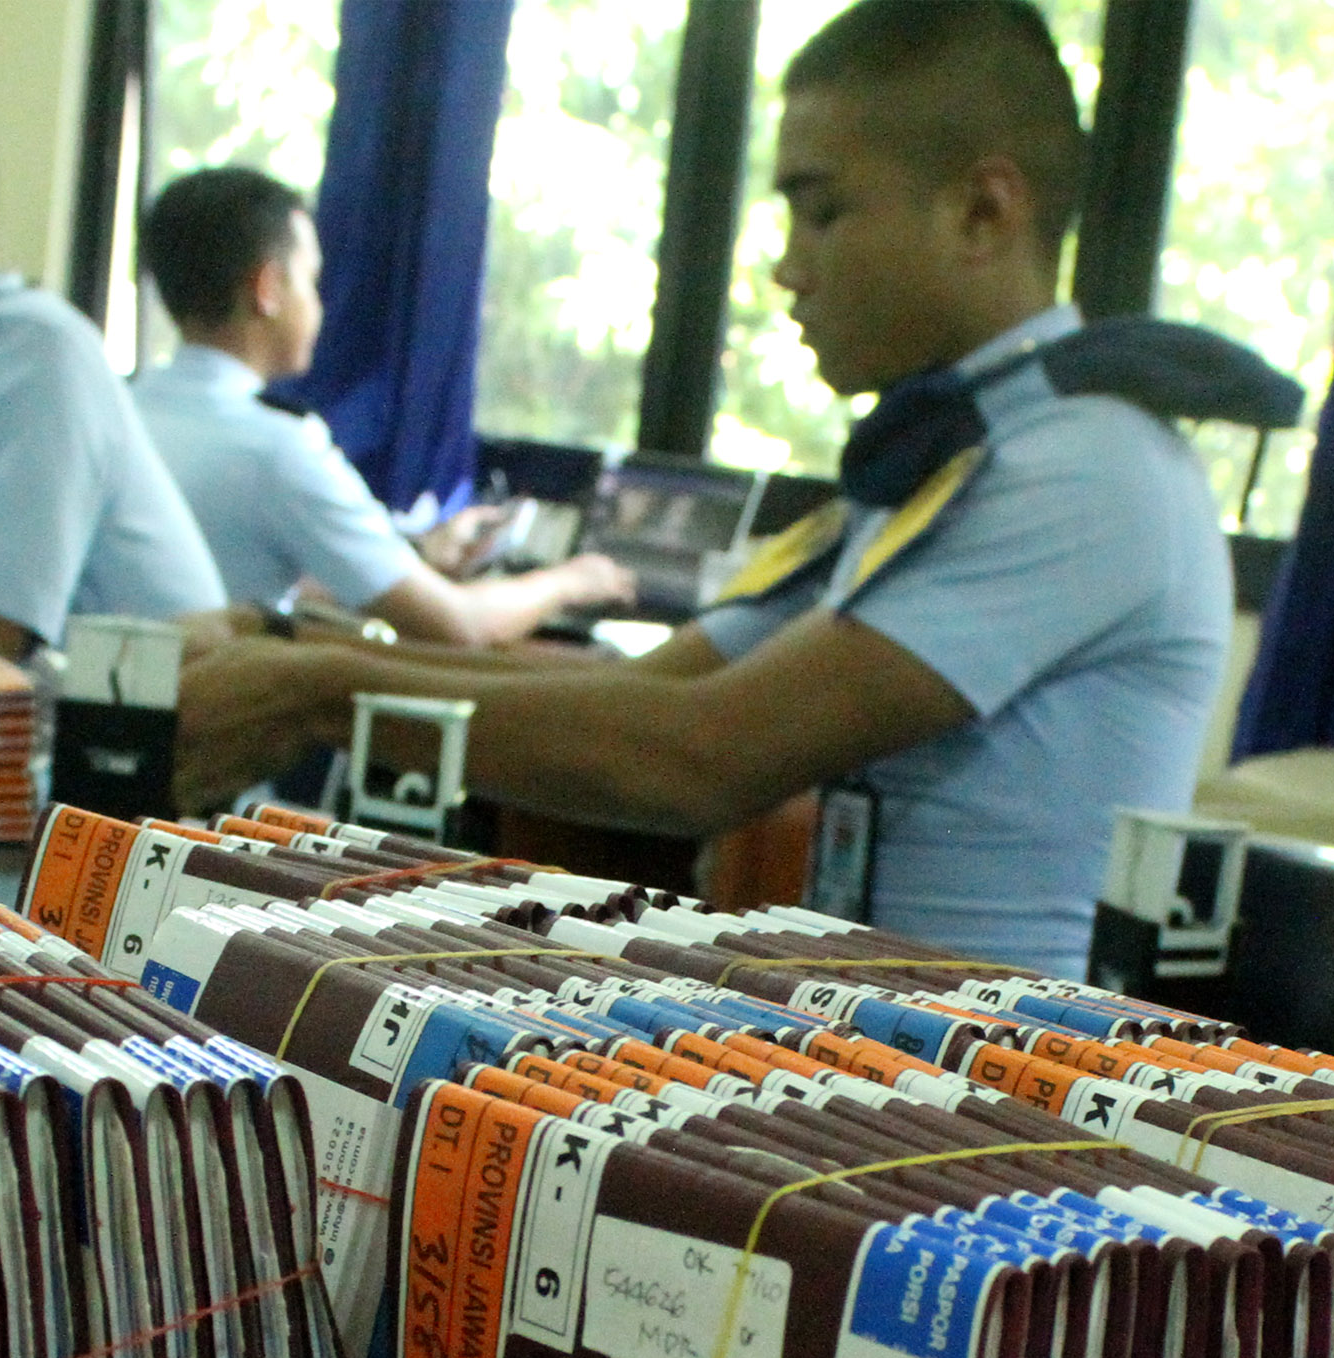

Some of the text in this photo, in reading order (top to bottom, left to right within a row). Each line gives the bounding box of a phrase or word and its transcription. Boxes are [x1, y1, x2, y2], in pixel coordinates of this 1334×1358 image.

[79, 825, 126, 926] PROVINSI
[123, 933, 143, 956] 6
[469, 1120, 518, 1271] PROVINSI
[458, 1273, 490, 1358] JAWA
[535, 1266, 561, 1299] 6
[899, 1249, 936, 1324] PORSI
[928, 1253, 970, 1351] PASPOR
